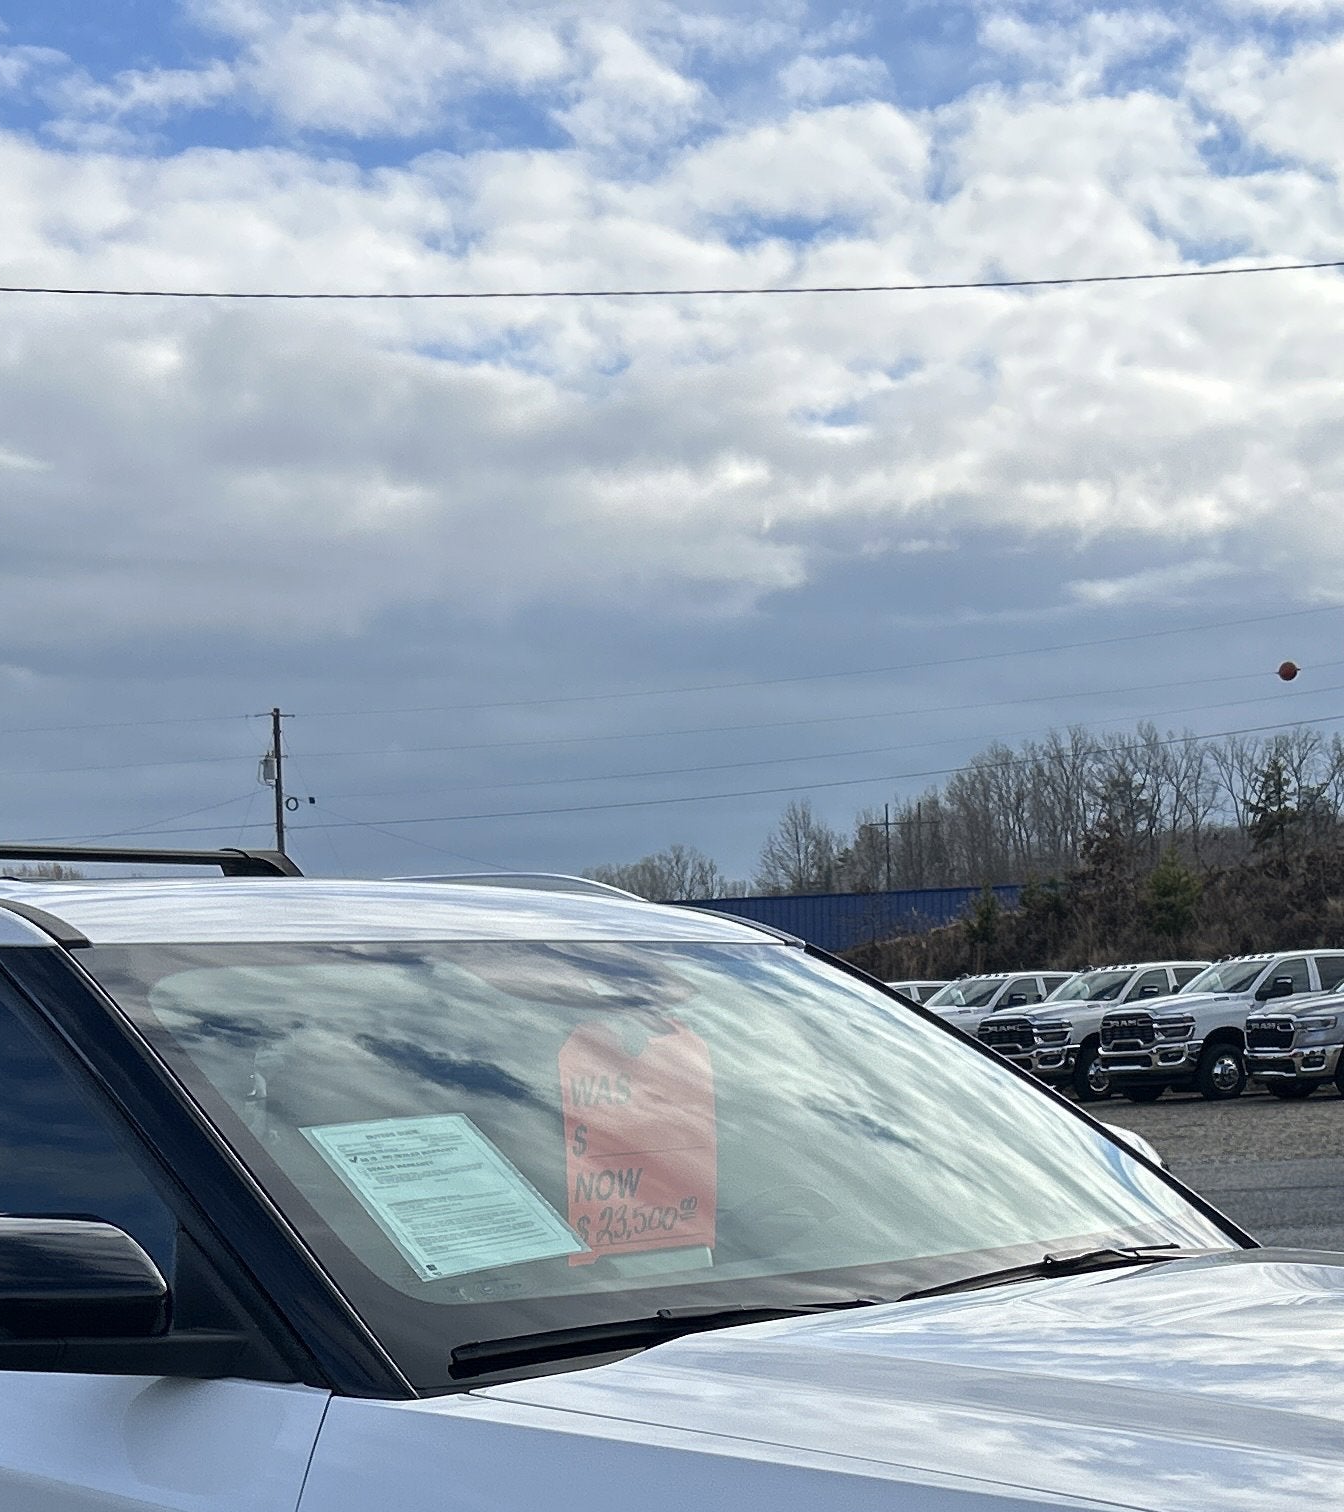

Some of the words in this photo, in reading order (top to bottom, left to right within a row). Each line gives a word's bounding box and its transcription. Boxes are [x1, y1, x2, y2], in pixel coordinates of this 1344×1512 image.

[1252, 1022, 1276, 1030] RAM
[570, 1073, 632, 1107] WAS
[572, 1124, 588, 1158] $
[574, 1167, 643, 1203] NOW
